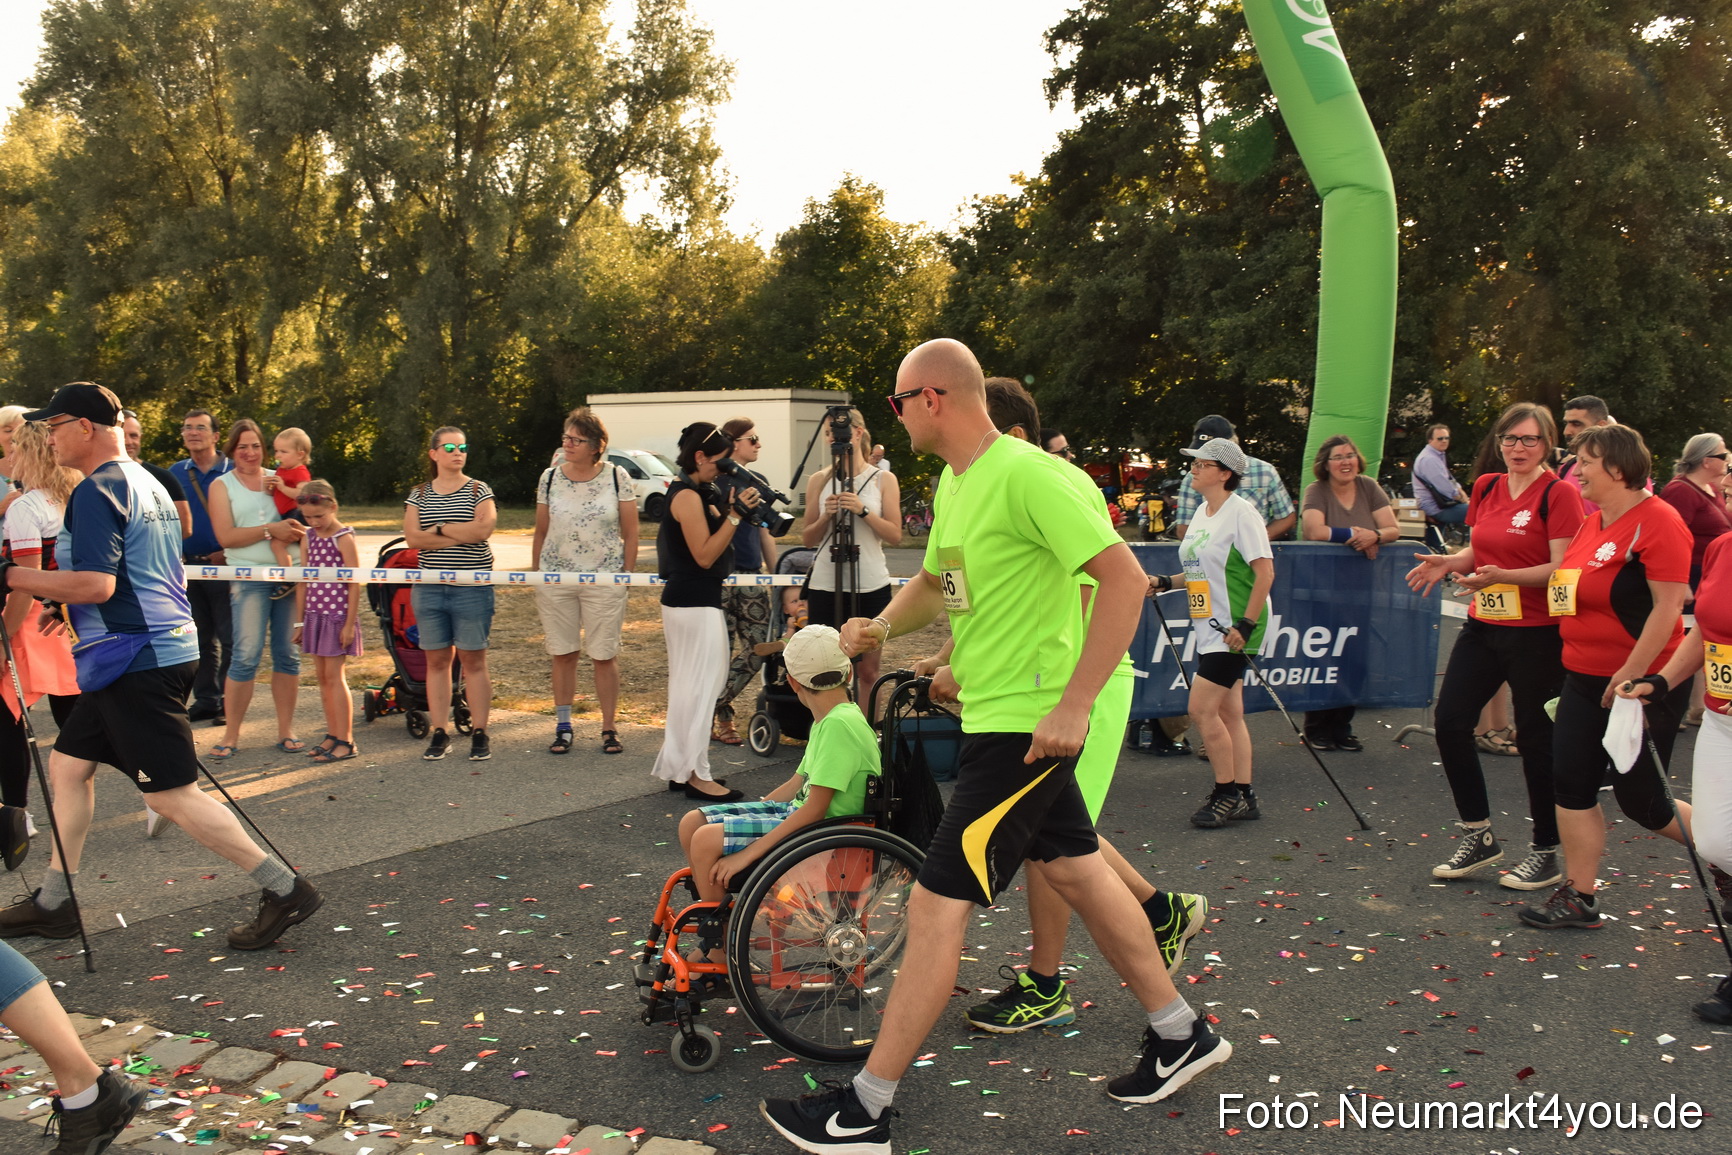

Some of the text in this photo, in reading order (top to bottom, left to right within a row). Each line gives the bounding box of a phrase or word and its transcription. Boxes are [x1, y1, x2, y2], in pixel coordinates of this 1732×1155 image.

[1480, 592, 1505, 609] 361
[1151, 614, 1358, 663] Fiher
[1169, 666, 1339, 691] AMOBILE
[1710, 662, 1732, 684] 36
